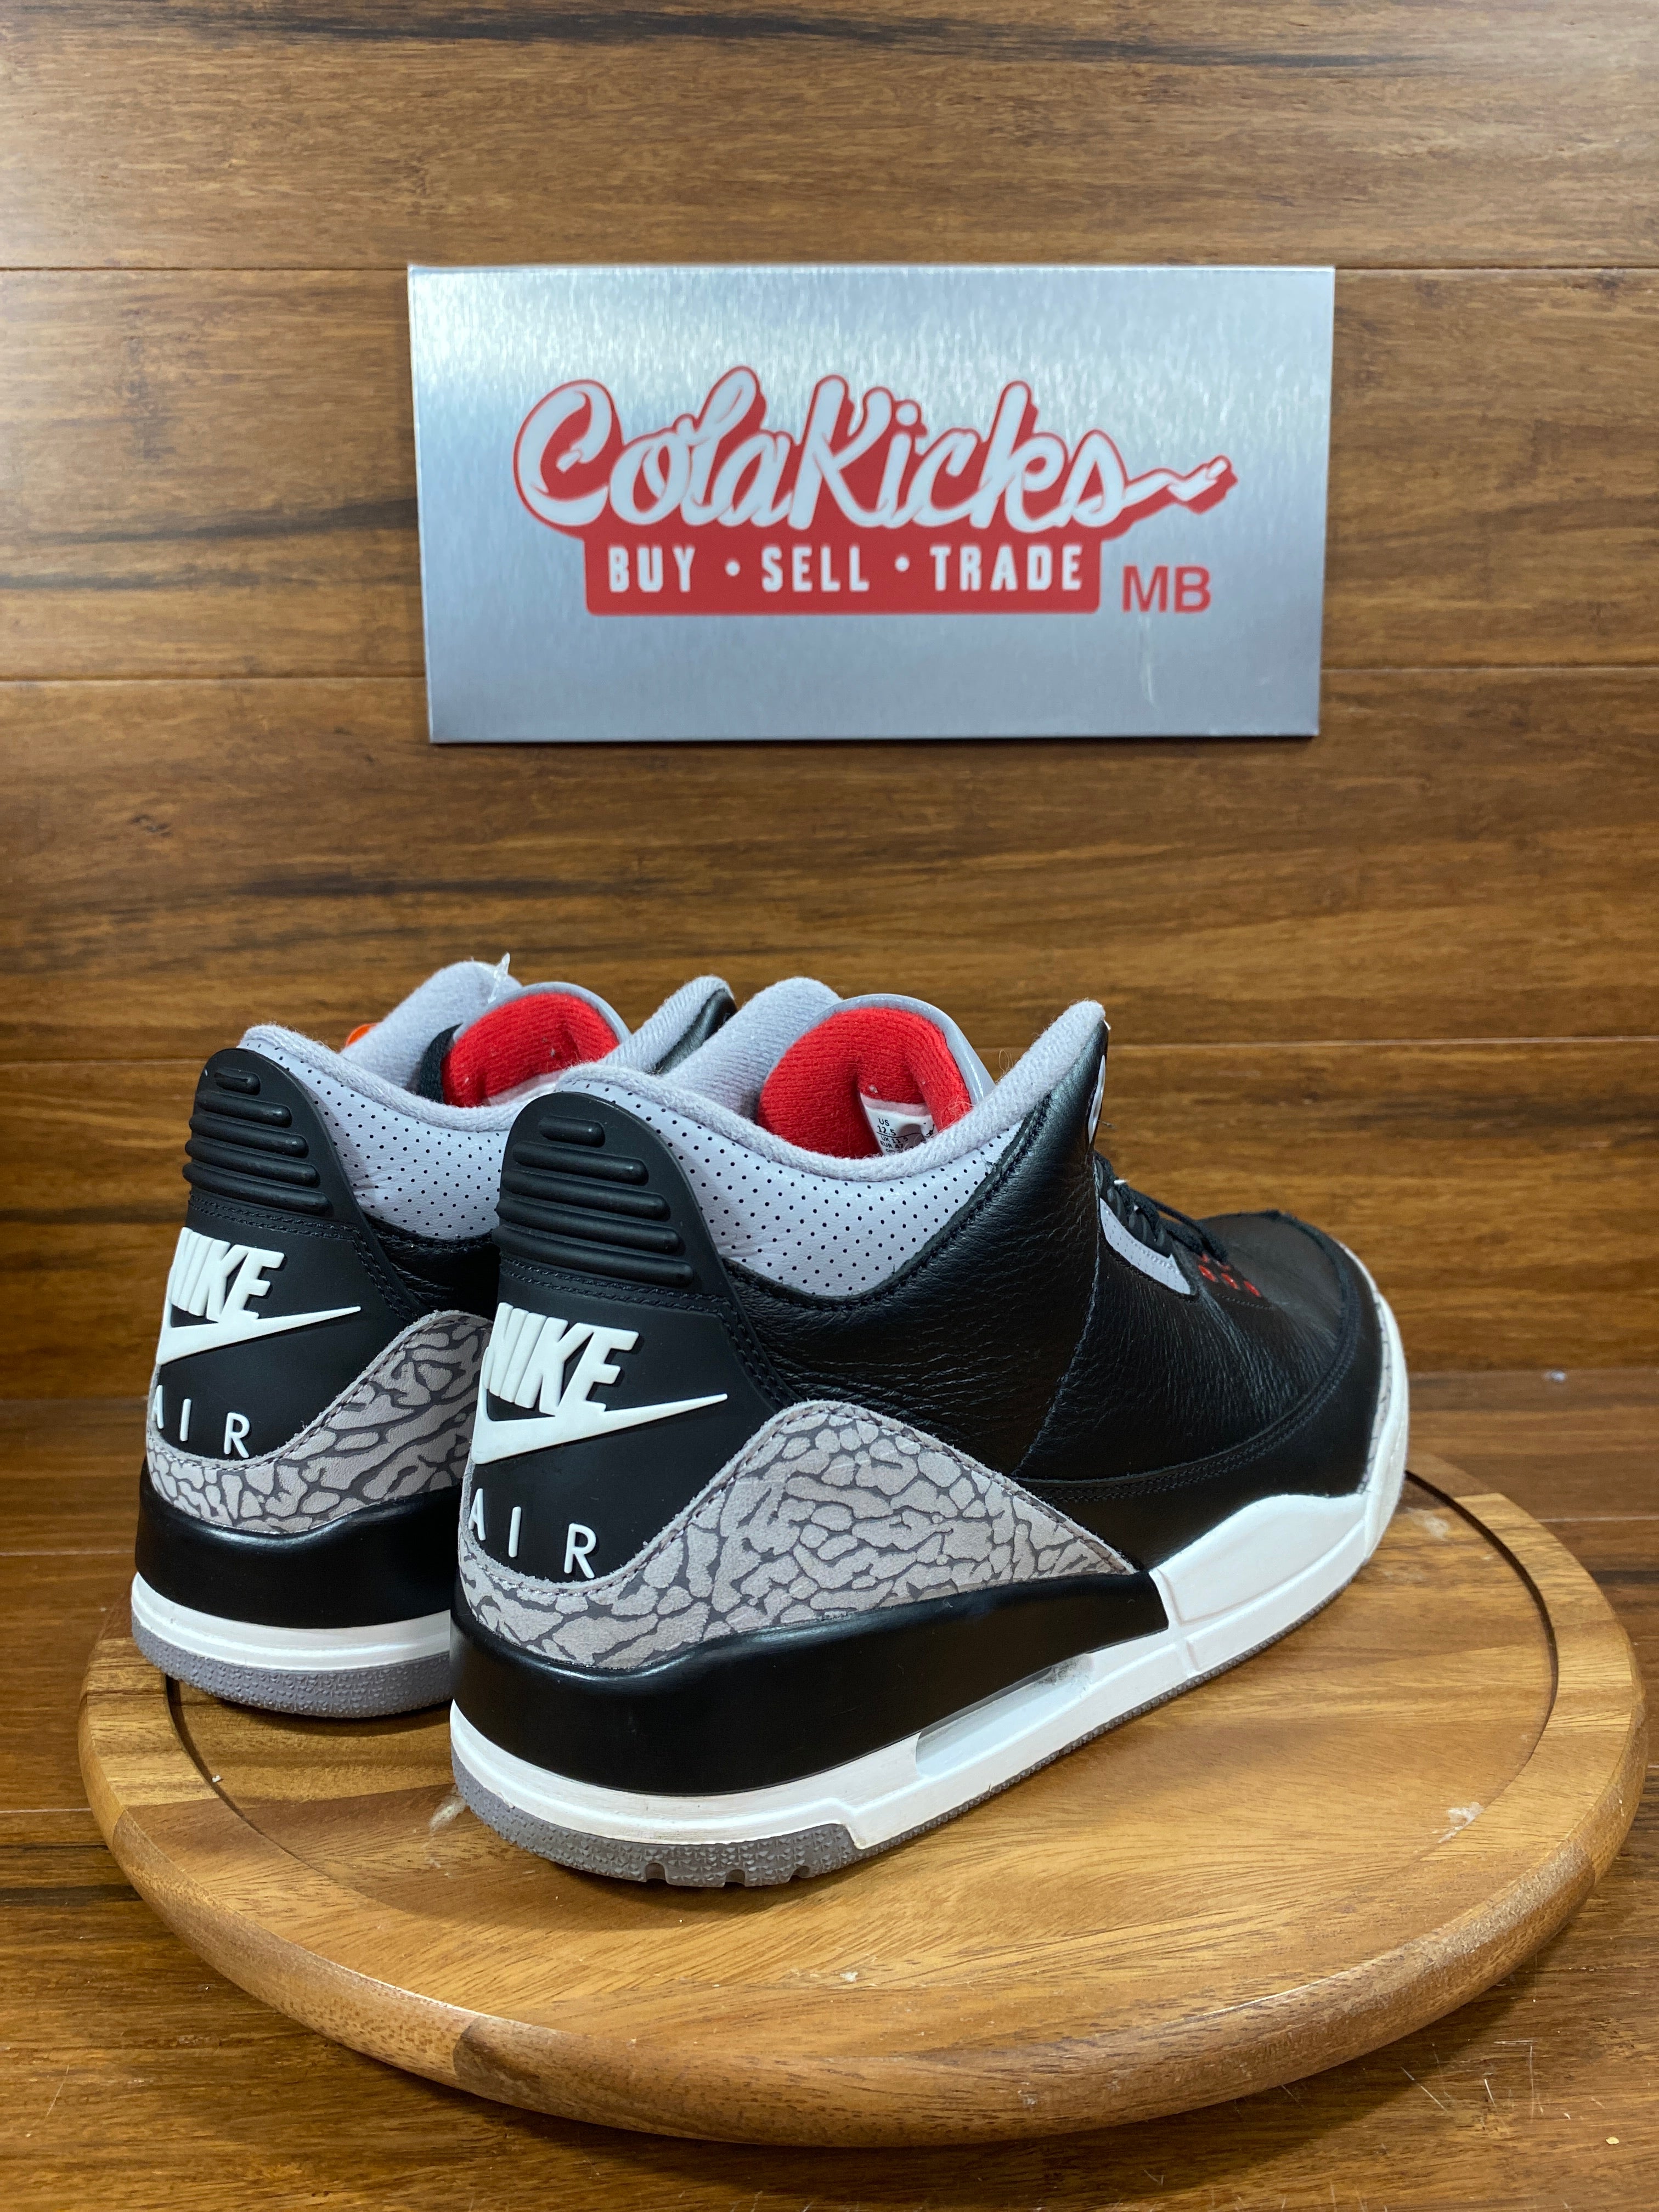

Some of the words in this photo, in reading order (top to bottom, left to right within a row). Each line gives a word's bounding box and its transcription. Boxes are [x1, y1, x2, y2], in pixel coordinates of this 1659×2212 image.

[608, 545, 695, 592] BUY
[761, 544, 869, 592] SELL
[930, 544, 1083, 591] TRADE
[1122, 565, 1211, 613] MB
[877, 1125, 896, 1136] 12.5
[878, 1118, 890, 1127] US
[880, 1140, 893, 1149] EUR
[167, 1227, 285, 1324] NIKE
[482, 1302, 639, 1417] NIKE
[469, 1488, 597, 1579] AIR
